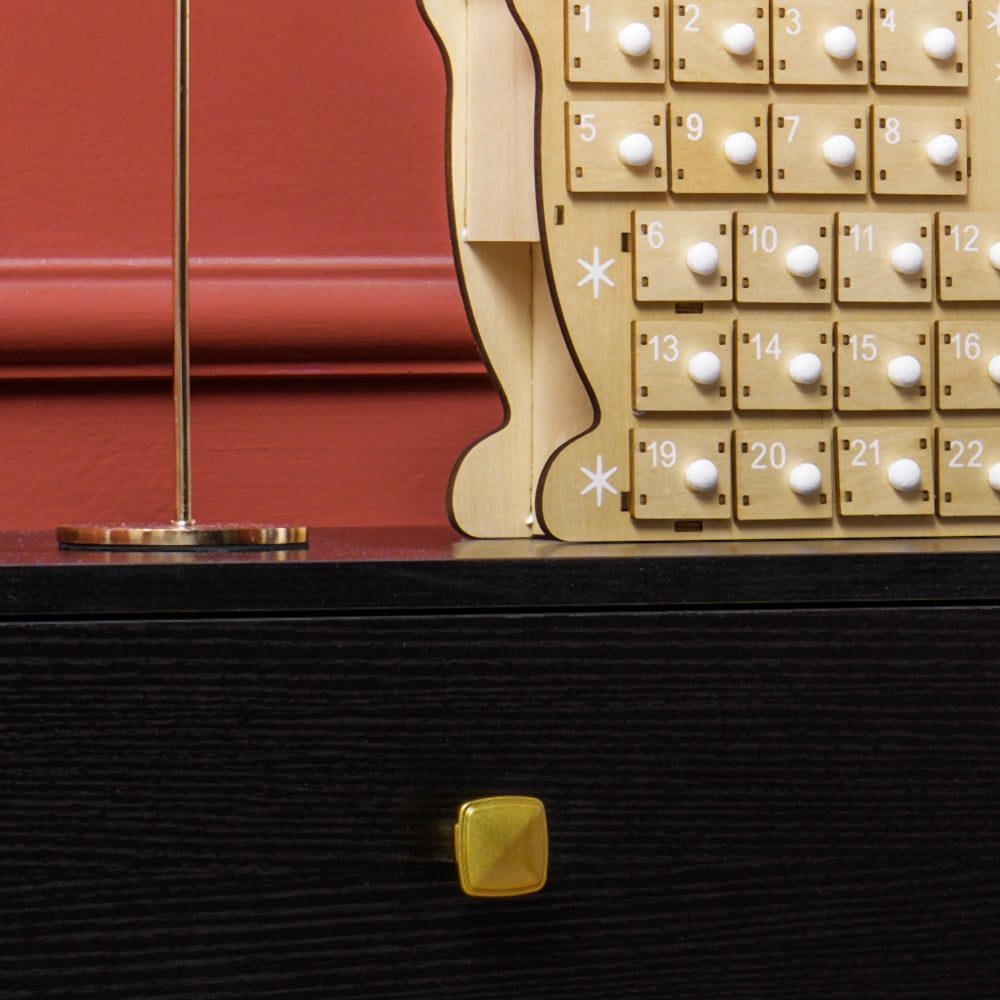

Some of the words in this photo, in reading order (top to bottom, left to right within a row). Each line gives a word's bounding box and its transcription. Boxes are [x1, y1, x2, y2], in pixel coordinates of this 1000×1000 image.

[580, 4, 592, 32] 1
[684, 3, 702, 32] 2
[786, 7, 803, 36] 3
[881, 3, 898, 33] 4
[580, 113, 598, 142] 5
[686, 112, 705, 141] 9
[785, 114, 802, 143] 7
[884, 116, 902, 145] 8
[648, 220, 666, 249] 6
[748, 225, 780, 253] 10
[849, 224, 875, 252] 11
[950, 223, 981, 252] 12
[648, 333, 681, 362] 13
[750, 332, 784, 361] 14
[848, 333, 879, 361] 15
[951, 332, 983, 360] 16
[646, 439, 679, 468] 19
[751, 441, 788, 469] 20
[852, 439, 881, 467] 21
[949, 439, 985, 468] 22
